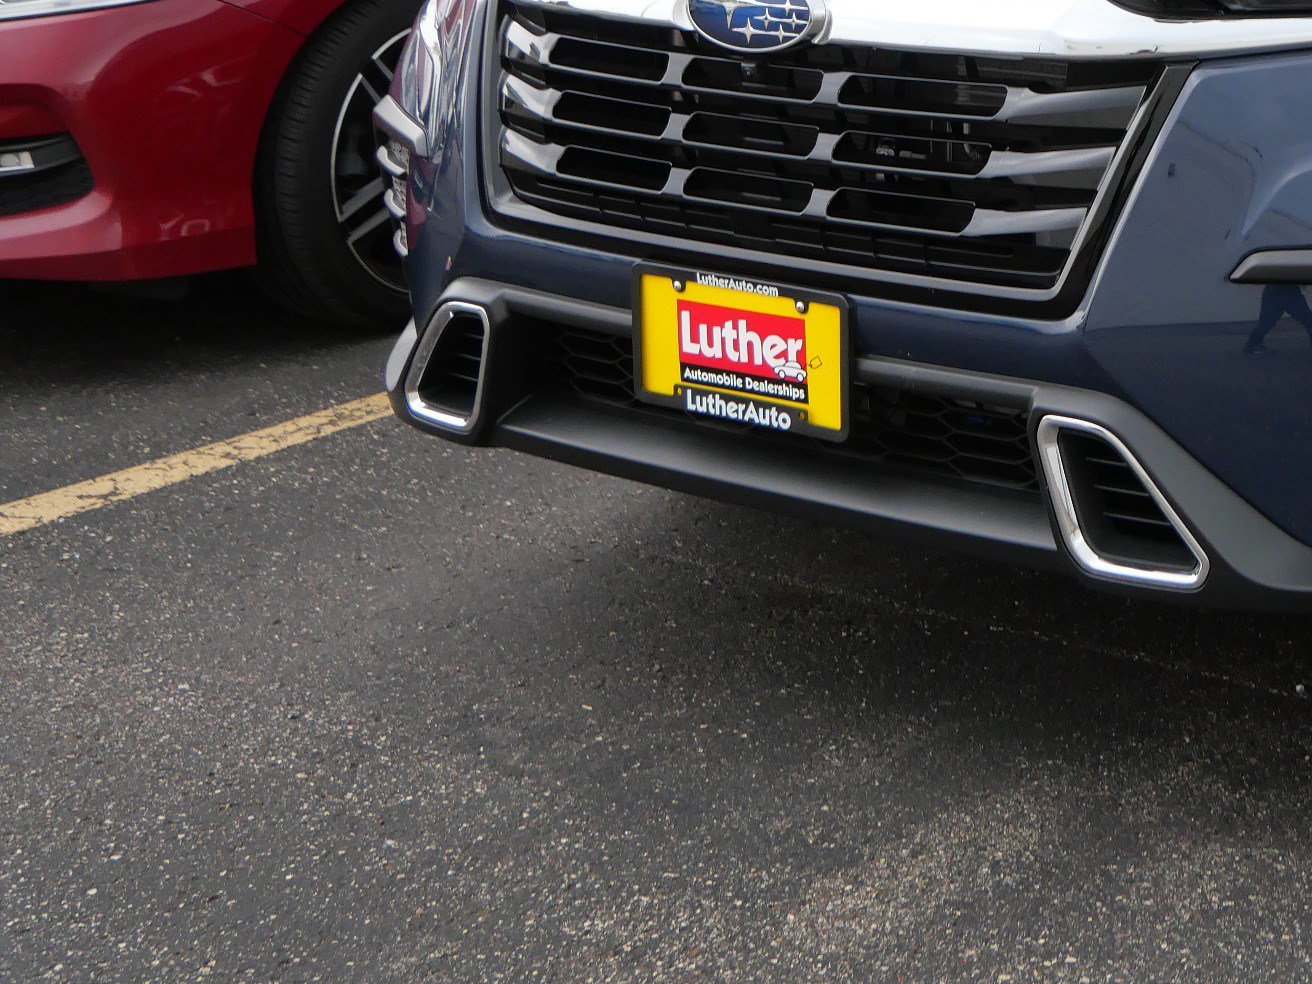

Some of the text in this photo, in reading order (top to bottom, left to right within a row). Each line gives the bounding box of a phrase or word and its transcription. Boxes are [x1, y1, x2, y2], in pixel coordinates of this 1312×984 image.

[696, 272, 779, 297] LutherAuto.com
[681, 310, 803, 371] Luther
[684, 366, 805, 400] Automobile Dealerships
[687, 389, 791, 430] LutherAuto
